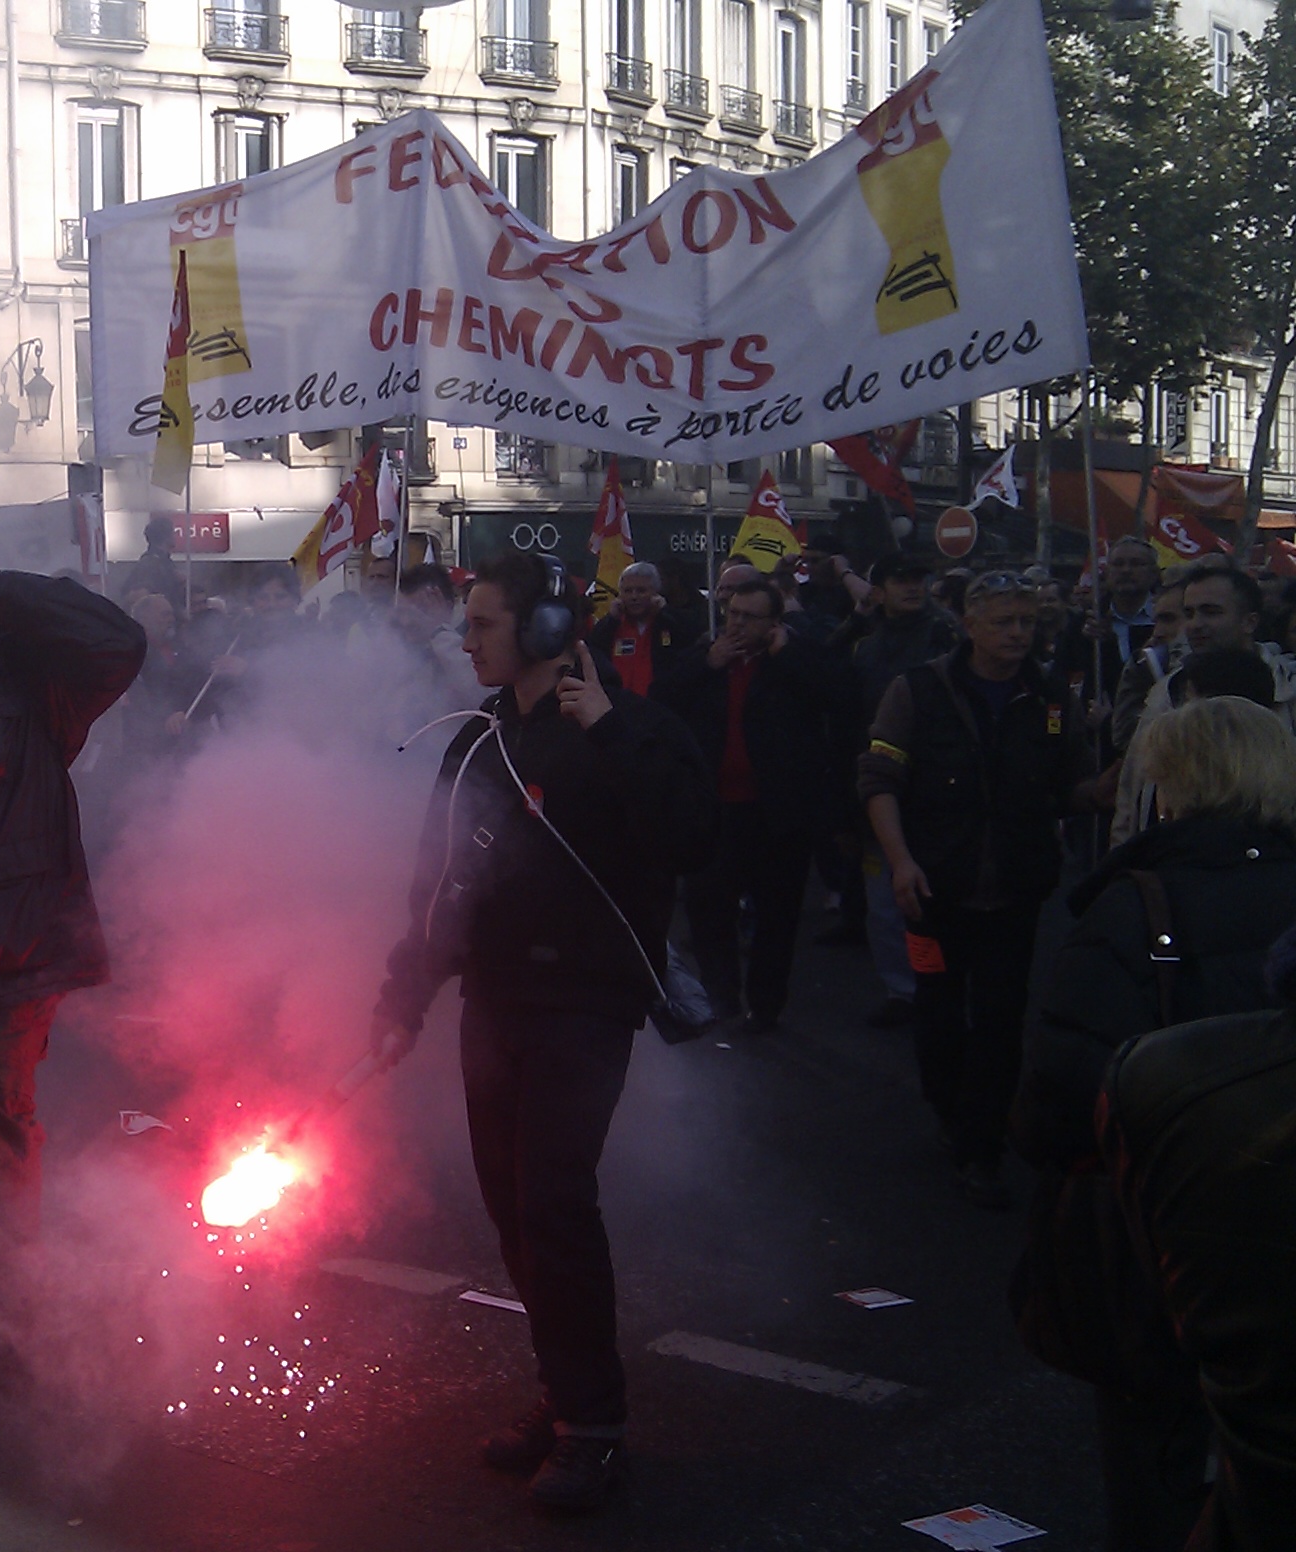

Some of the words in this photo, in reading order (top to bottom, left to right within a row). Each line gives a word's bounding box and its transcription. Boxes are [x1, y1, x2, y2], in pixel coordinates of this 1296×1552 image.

[169, 191, 241, 239] cgt
[369, 287, 776, 400] CHEMINOTS
[128, 370, 368, 437] Esemble,
[435, 374, 610, 428] exigences
[625, 403, 662, 437] à
[664, 393, 805, 448] portée
[822, 364, 880, 411] de
[900, 319, 1043, 389] voies
[174, 521, 222, 538] ndré
[670, 530, 728, 552] GÉNÉRLE
